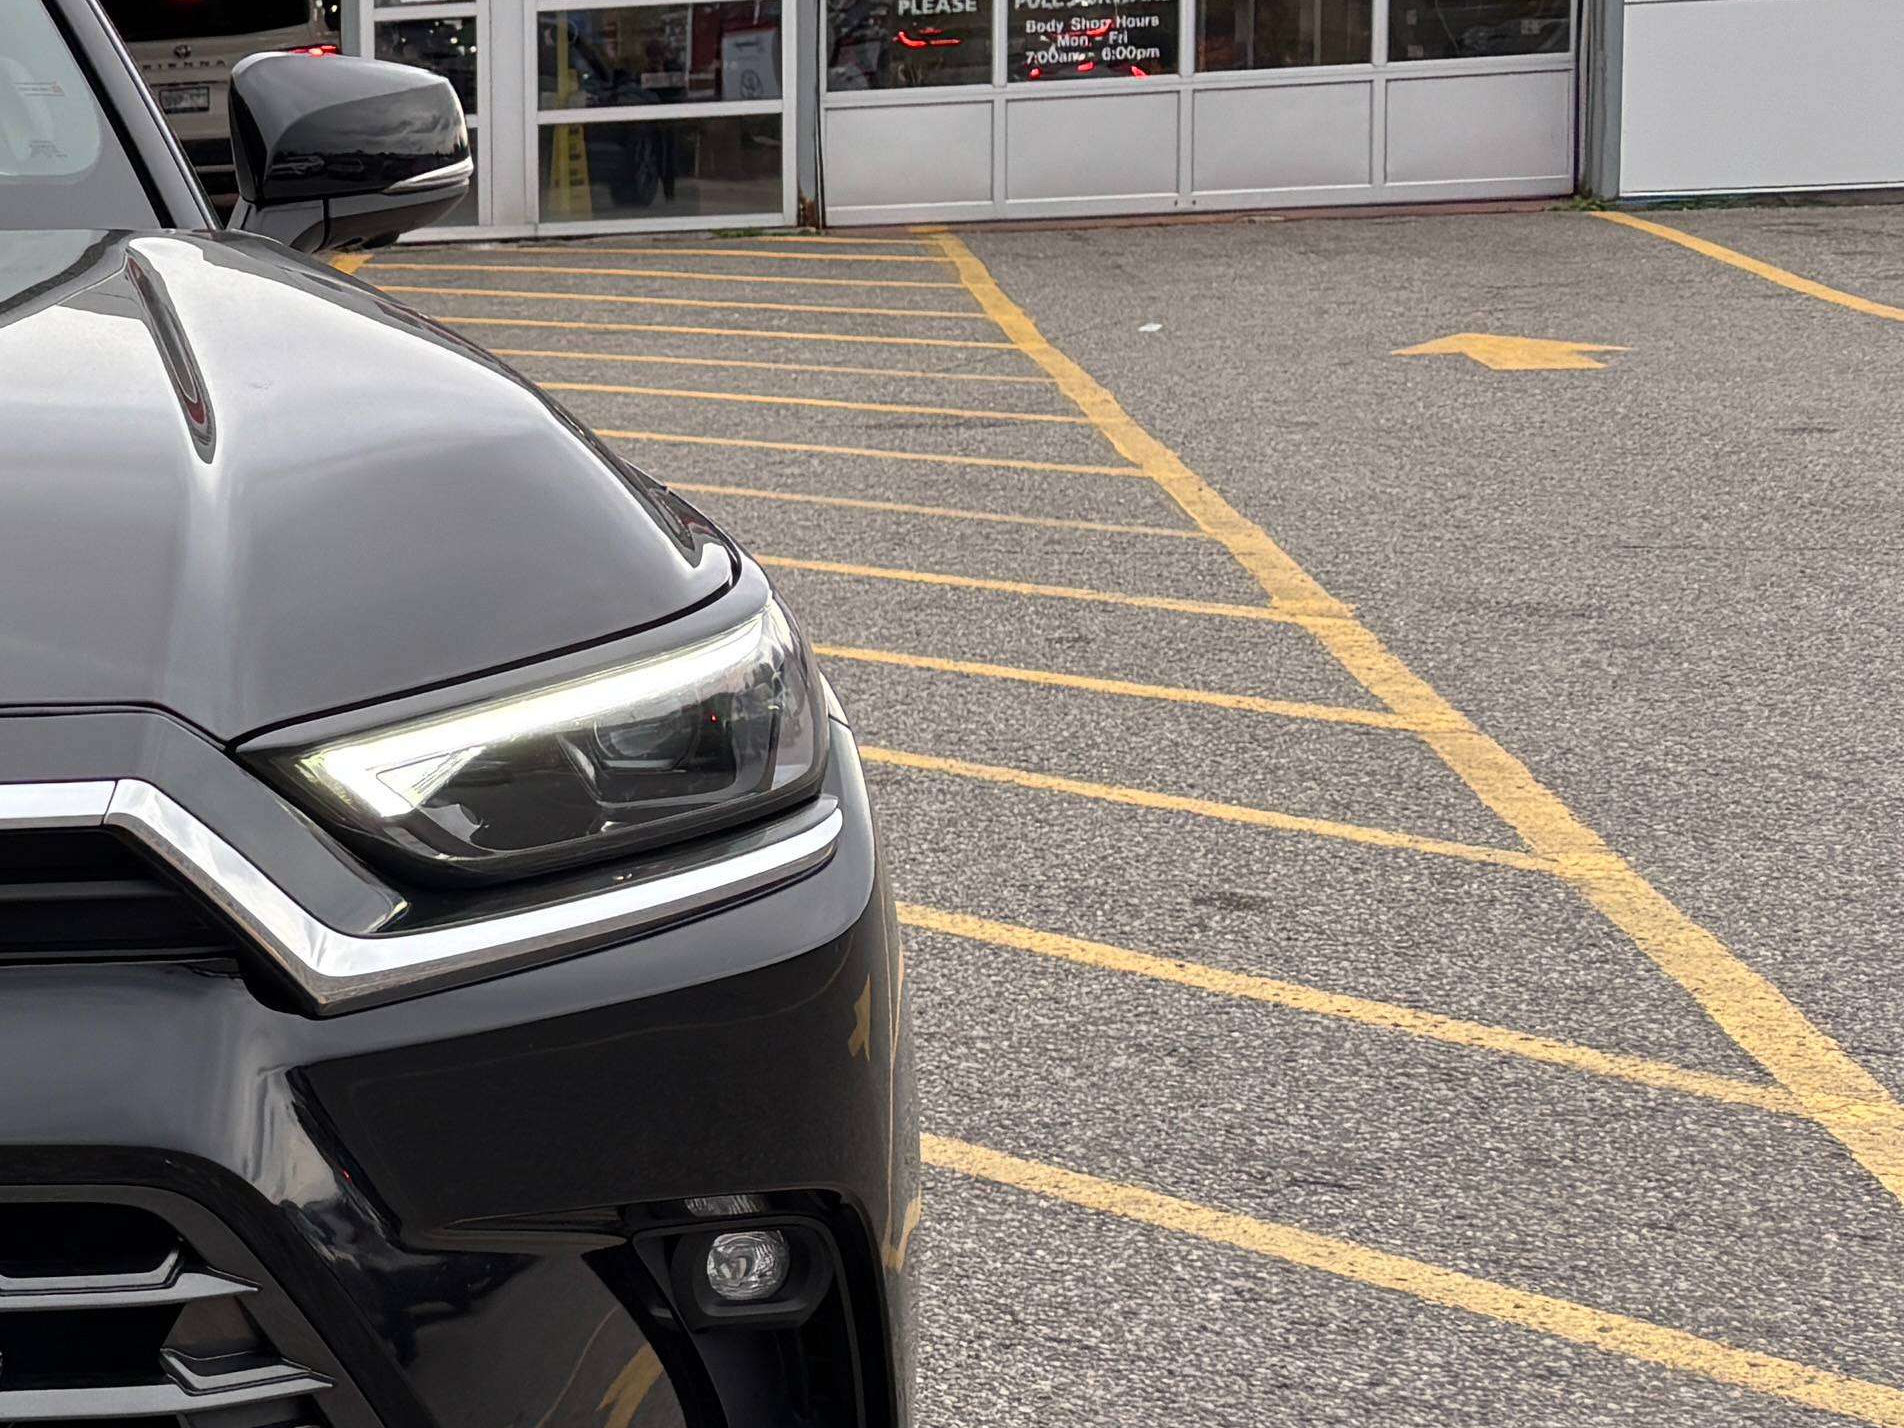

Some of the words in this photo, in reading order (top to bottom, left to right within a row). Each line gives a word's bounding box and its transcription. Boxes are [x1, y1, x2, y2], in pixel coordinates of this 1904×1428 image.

[1025, 19, 1064, 34] Body
[1071, 17, 1110, 33] Shop
[1116, 15, 1160, 28] Hours
[1108, 30, 1128, 44] Fri
[1101, 46, 1160, 61] 6:00pm
